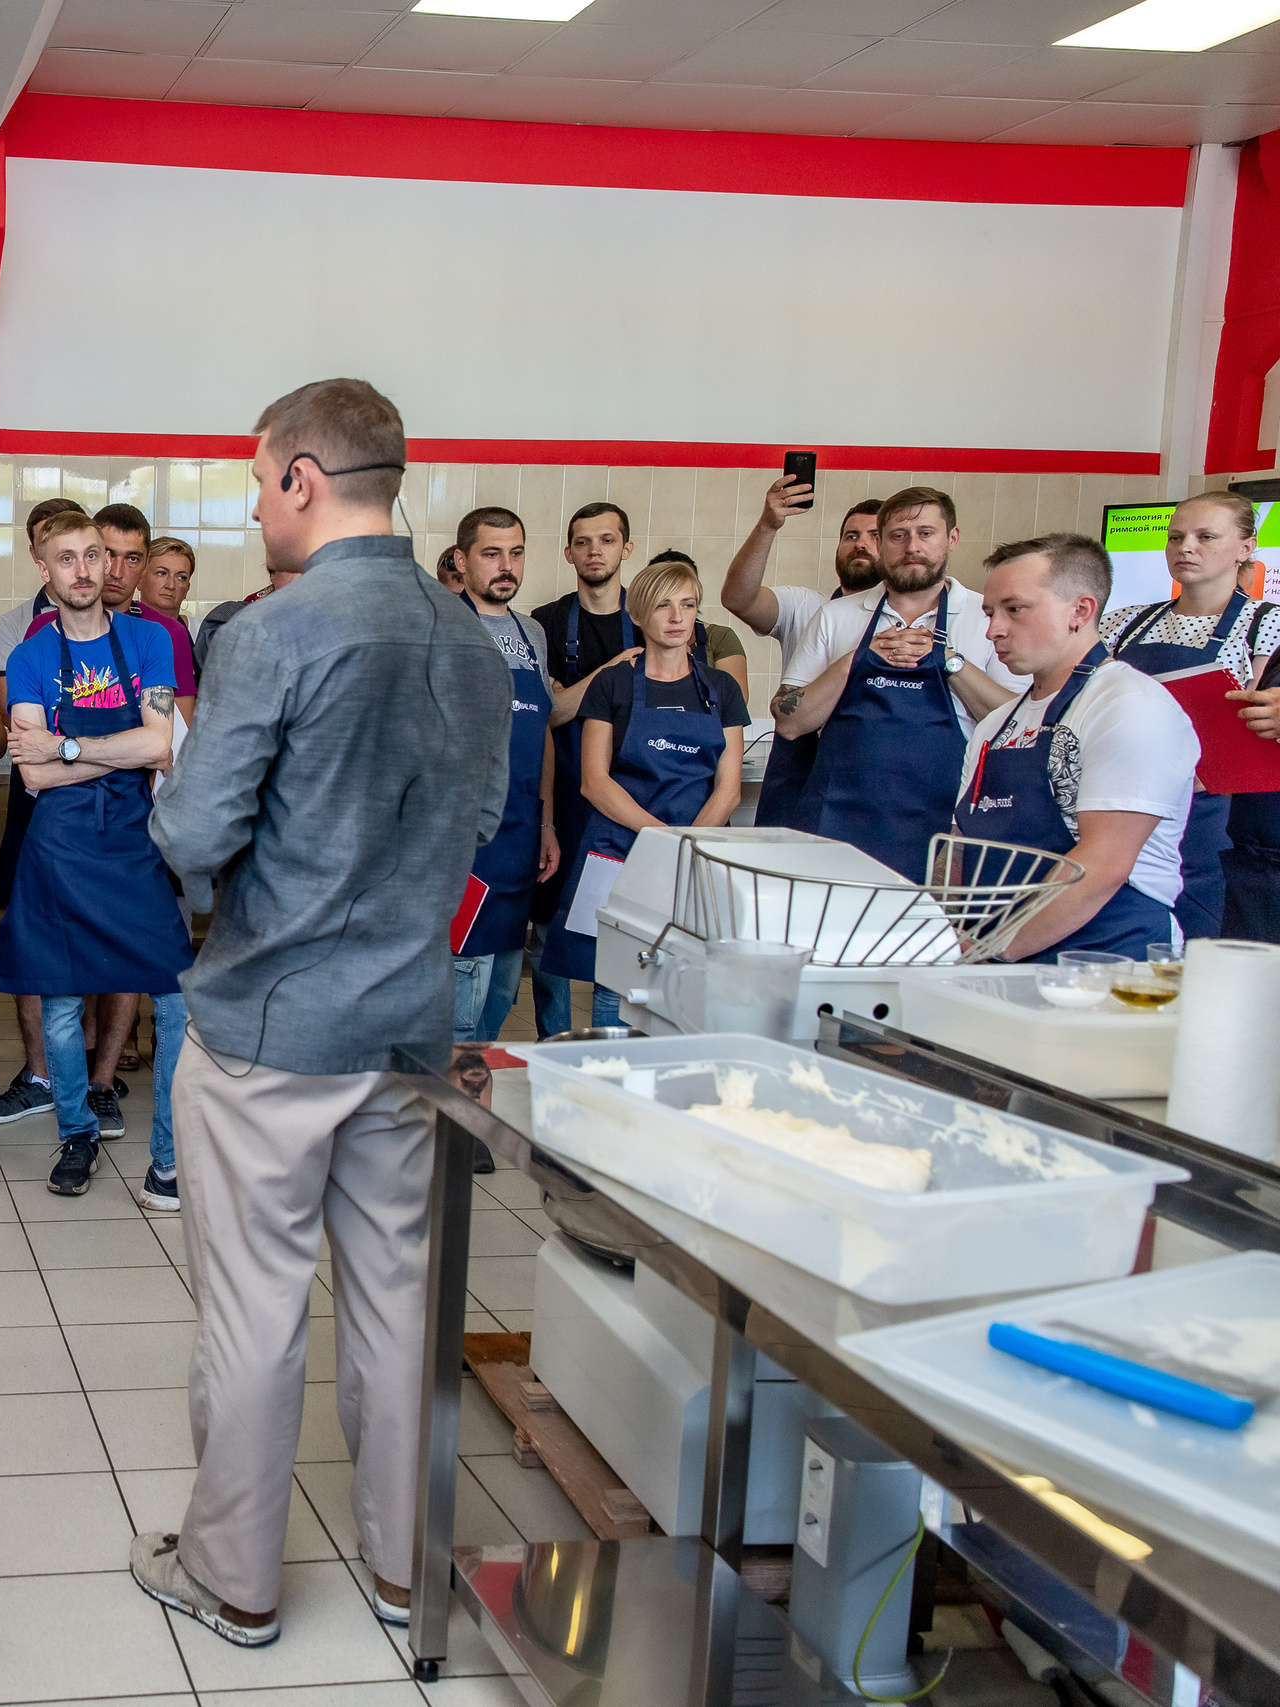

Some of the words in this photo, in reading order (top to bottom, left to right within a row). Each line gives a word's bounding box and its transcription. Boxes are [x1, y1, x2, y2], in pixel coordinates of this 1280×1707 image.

[1111, 514, 1162, 522] Технология
[1110, 525, 1150, 534] римской
[866, 676, 899, 689] GLOBAL
[900, 681, 924, 690] FOODS
[648, 738, 677, 750] GLOBAL
[677, 744, 700, 754] FOODS
